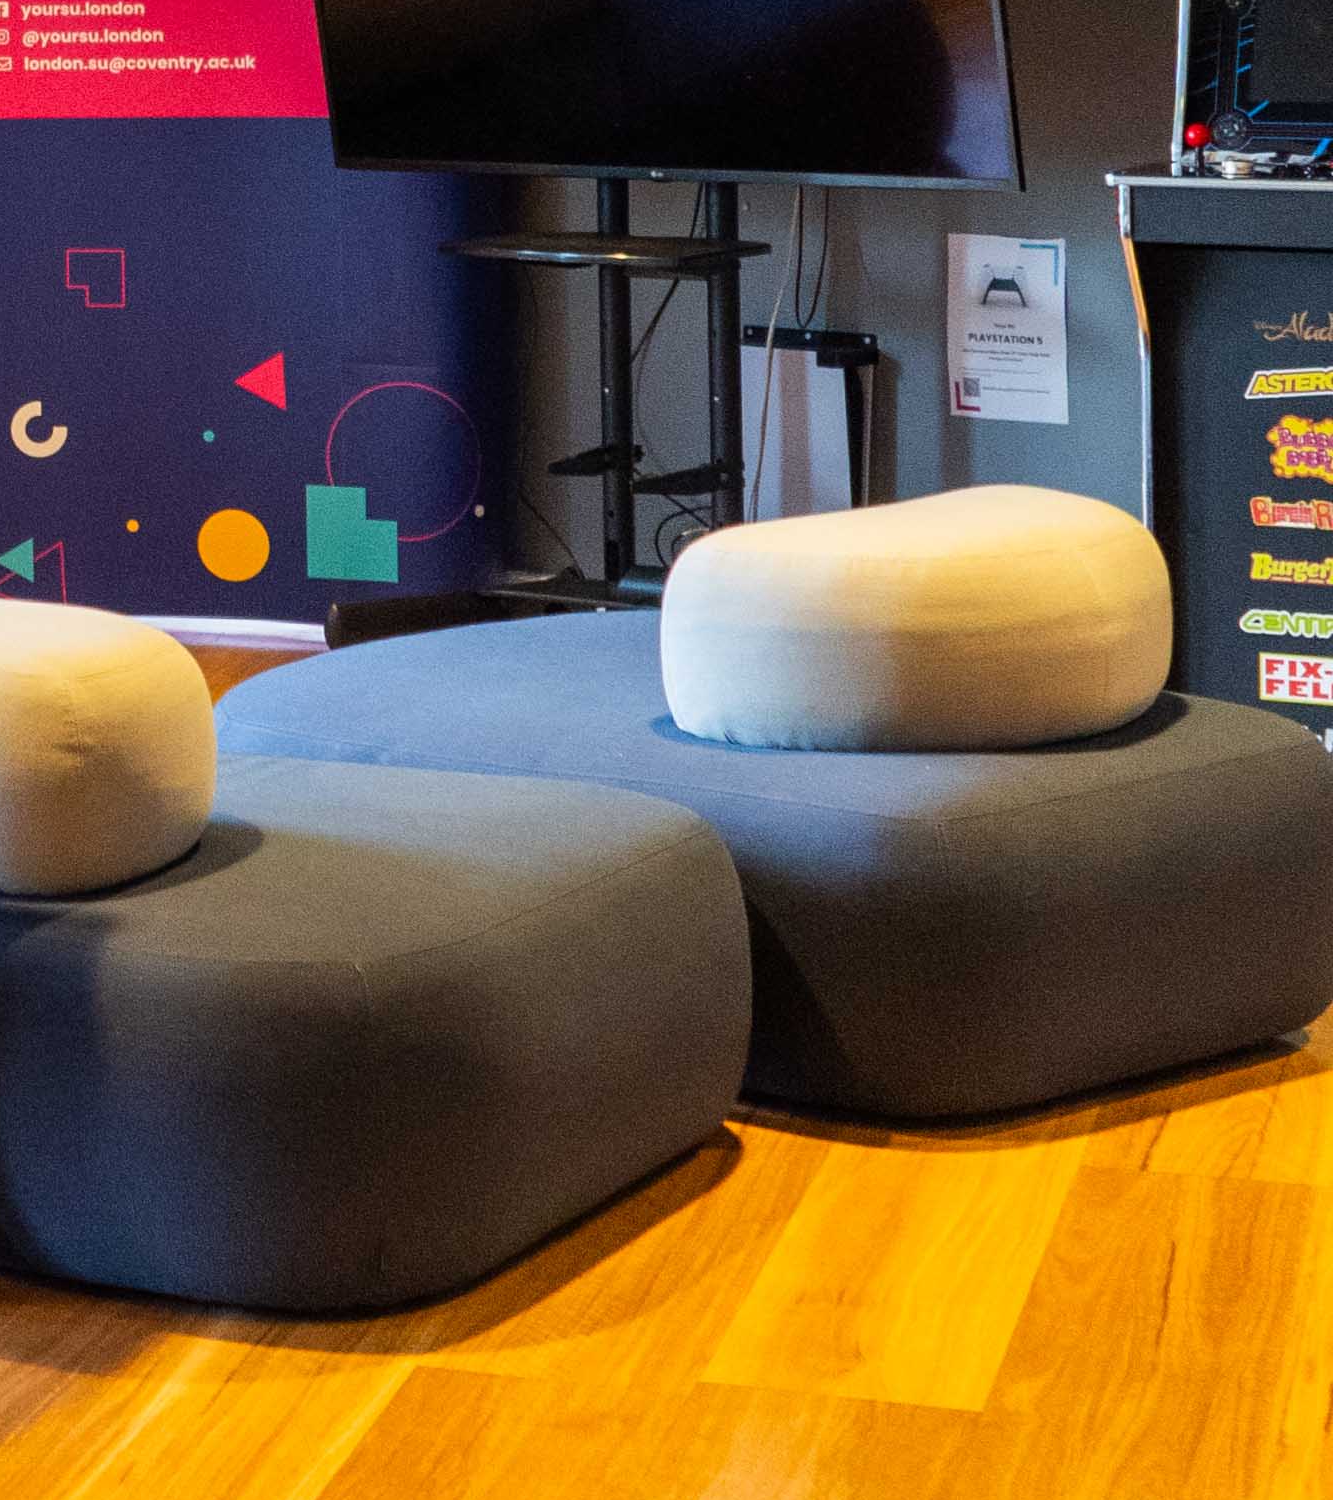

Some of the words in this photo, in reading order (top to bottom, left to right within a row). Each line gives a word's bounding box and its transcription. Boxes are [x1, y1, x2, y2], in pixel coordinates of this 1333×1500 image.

[20, 0, 146, 20] yoursu.london
[22, 28, 165, 49] @yoursu.london
[23, 54, 256, 75] london.su@coventry.ac.uk
[968, 333, 1035, 345] PLAYSTATION
[1036, 336, 1044, 345] 5
[1265, 680, 1333, 700] FEL
